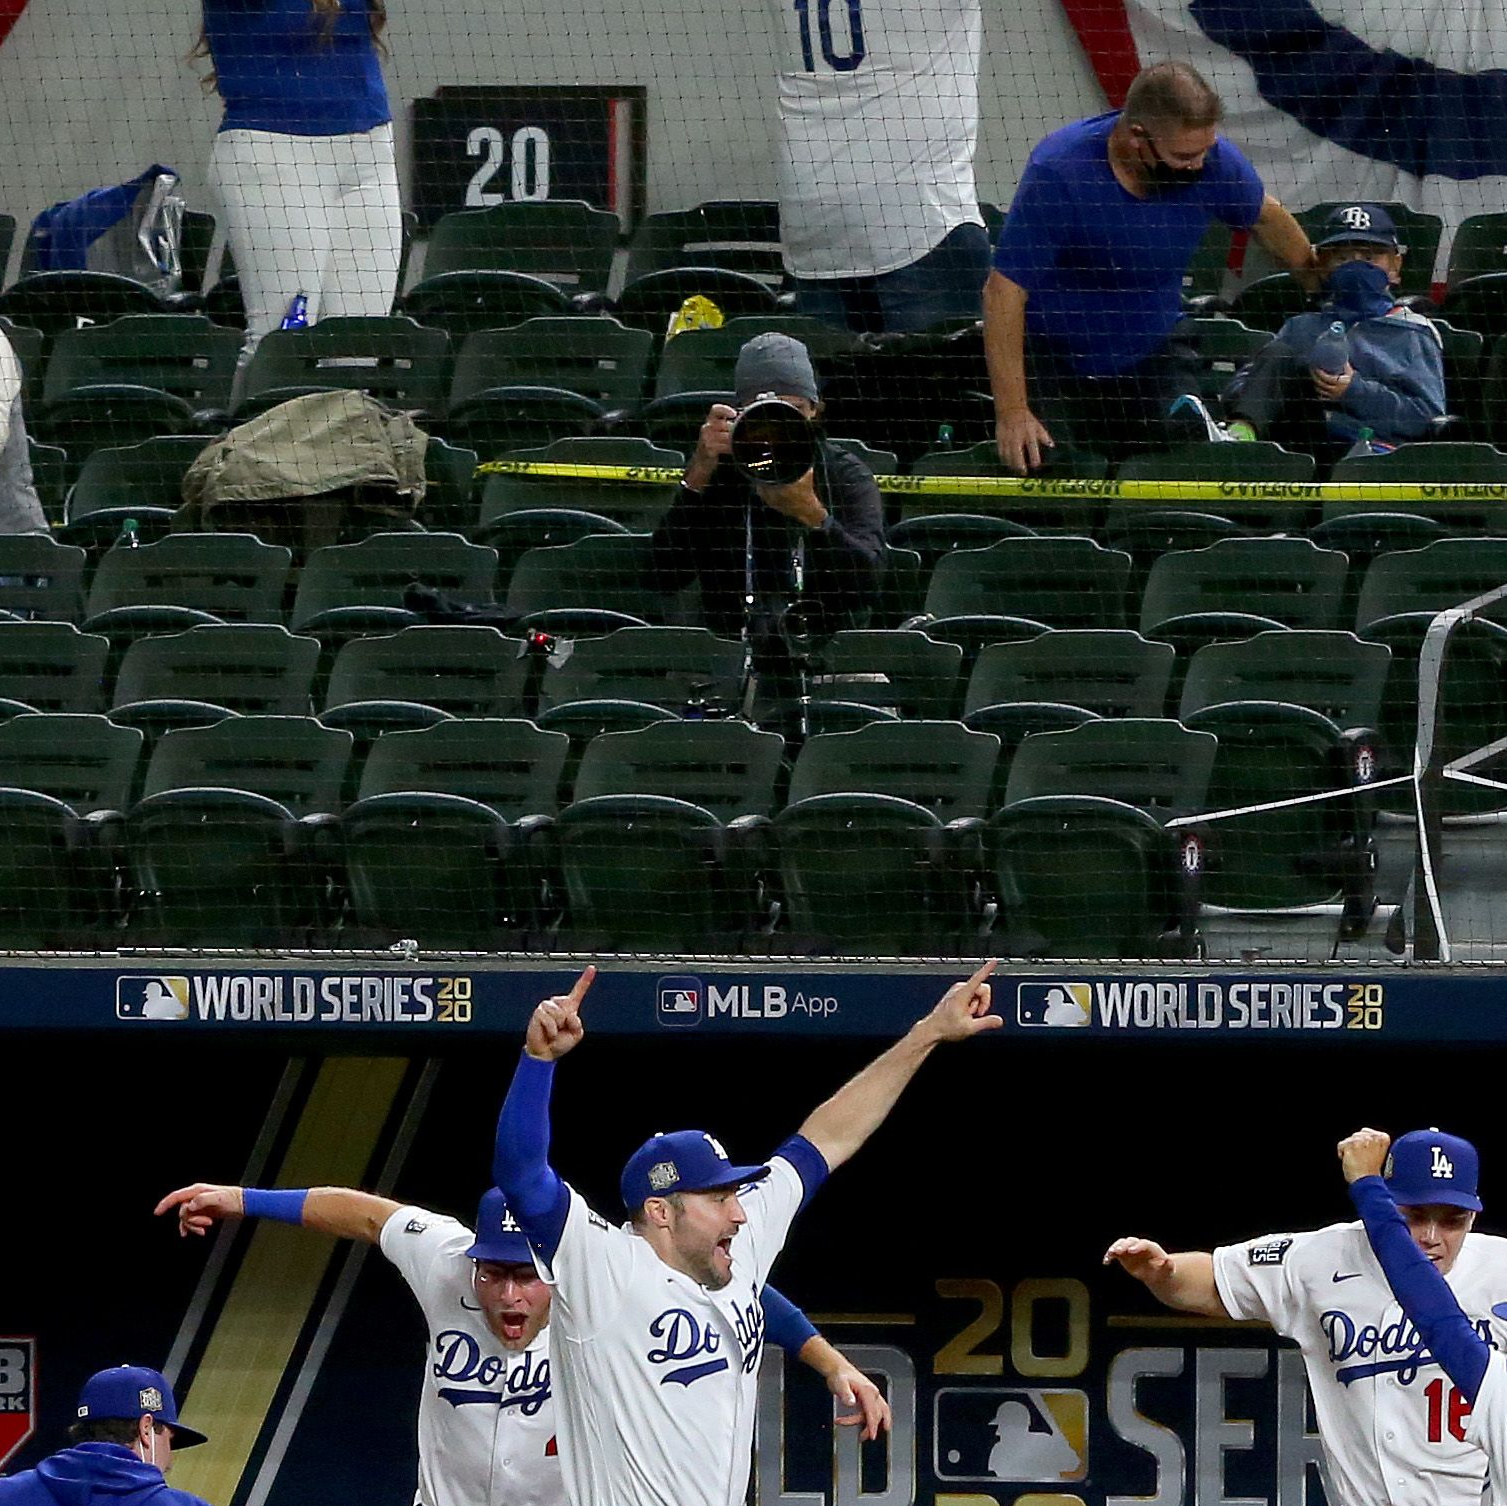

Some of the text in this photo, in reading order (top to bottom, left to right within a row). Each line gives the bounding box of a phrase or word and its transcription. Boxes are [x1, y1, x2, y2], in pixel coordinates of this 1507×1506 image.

[794, 0, 865, 72] 10
[466, 126, 550, 206] 20
[193, 976, 472, 1023] WORLD SERIES 20
[437, 1000, 472, 1023] 20
[707, 985, 839, 1018] MLB App
[1095, 982, 1384, 1030] WORLD SERIES 20
[1346, 1007, 1384, 1030] 20
[1431, 1146, 1454, 1179] LA
[932, 1277, 1091, 1377] 20
